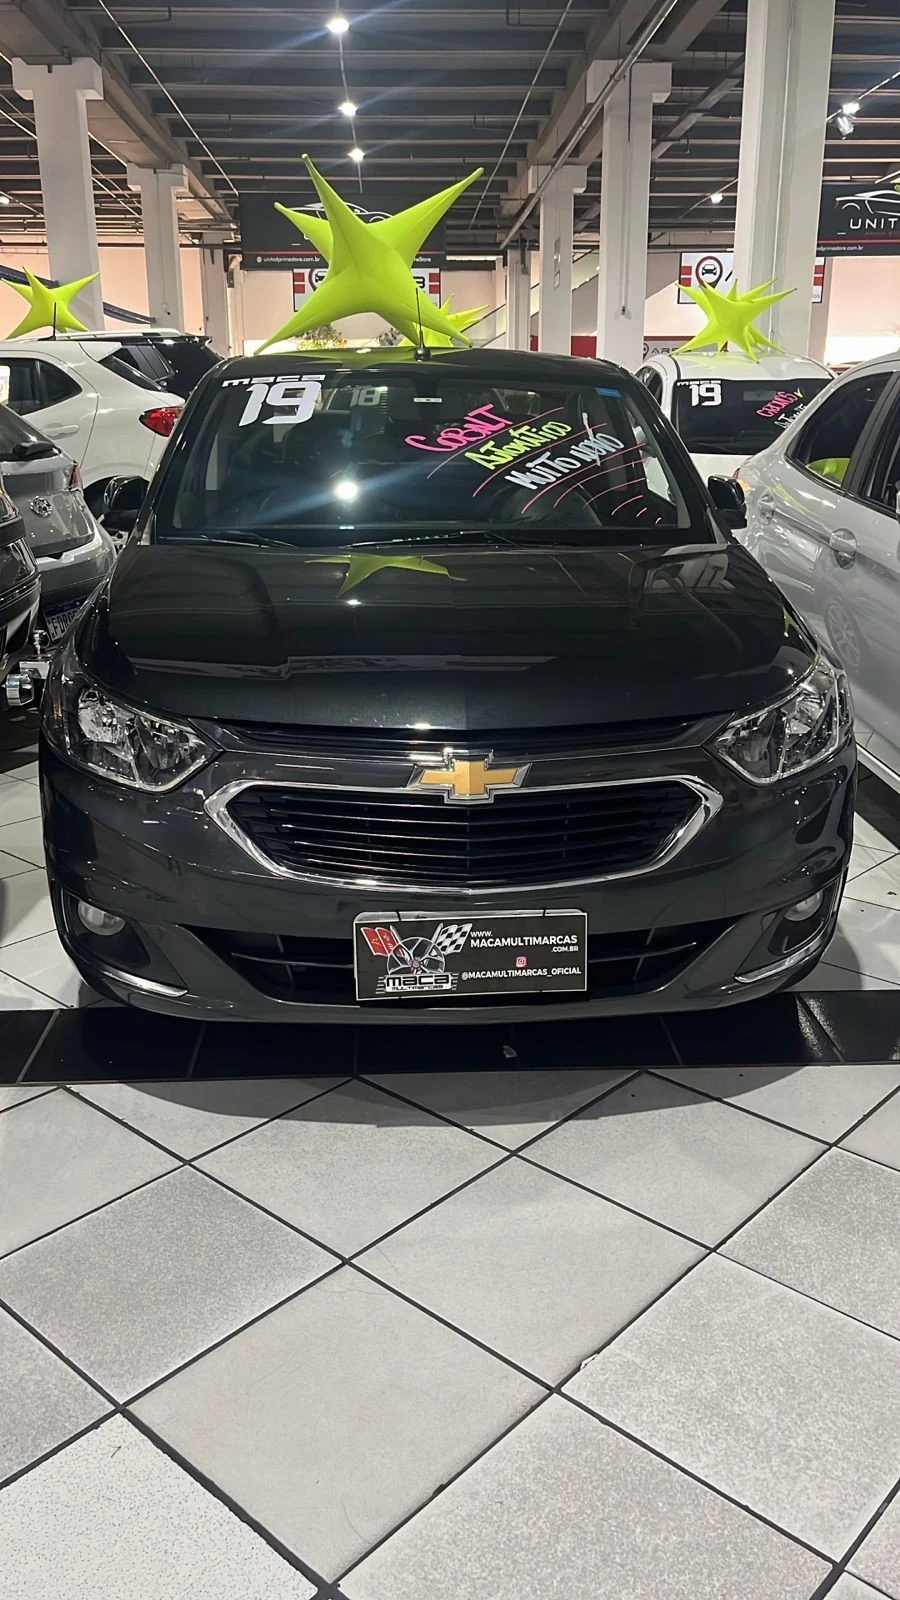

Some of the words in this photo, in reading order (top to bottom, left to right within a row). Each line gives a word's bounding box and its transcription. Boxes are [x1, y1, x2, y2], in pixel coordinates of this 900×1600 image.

[238, 380, 322, 427] 19
[689, 383, 722, 407] 19
[470, 935, 578, 948] MACAMULTIMARCAS
[461, 967, 582, 980] @MACAMULTIMARCAS_OFICIAL
